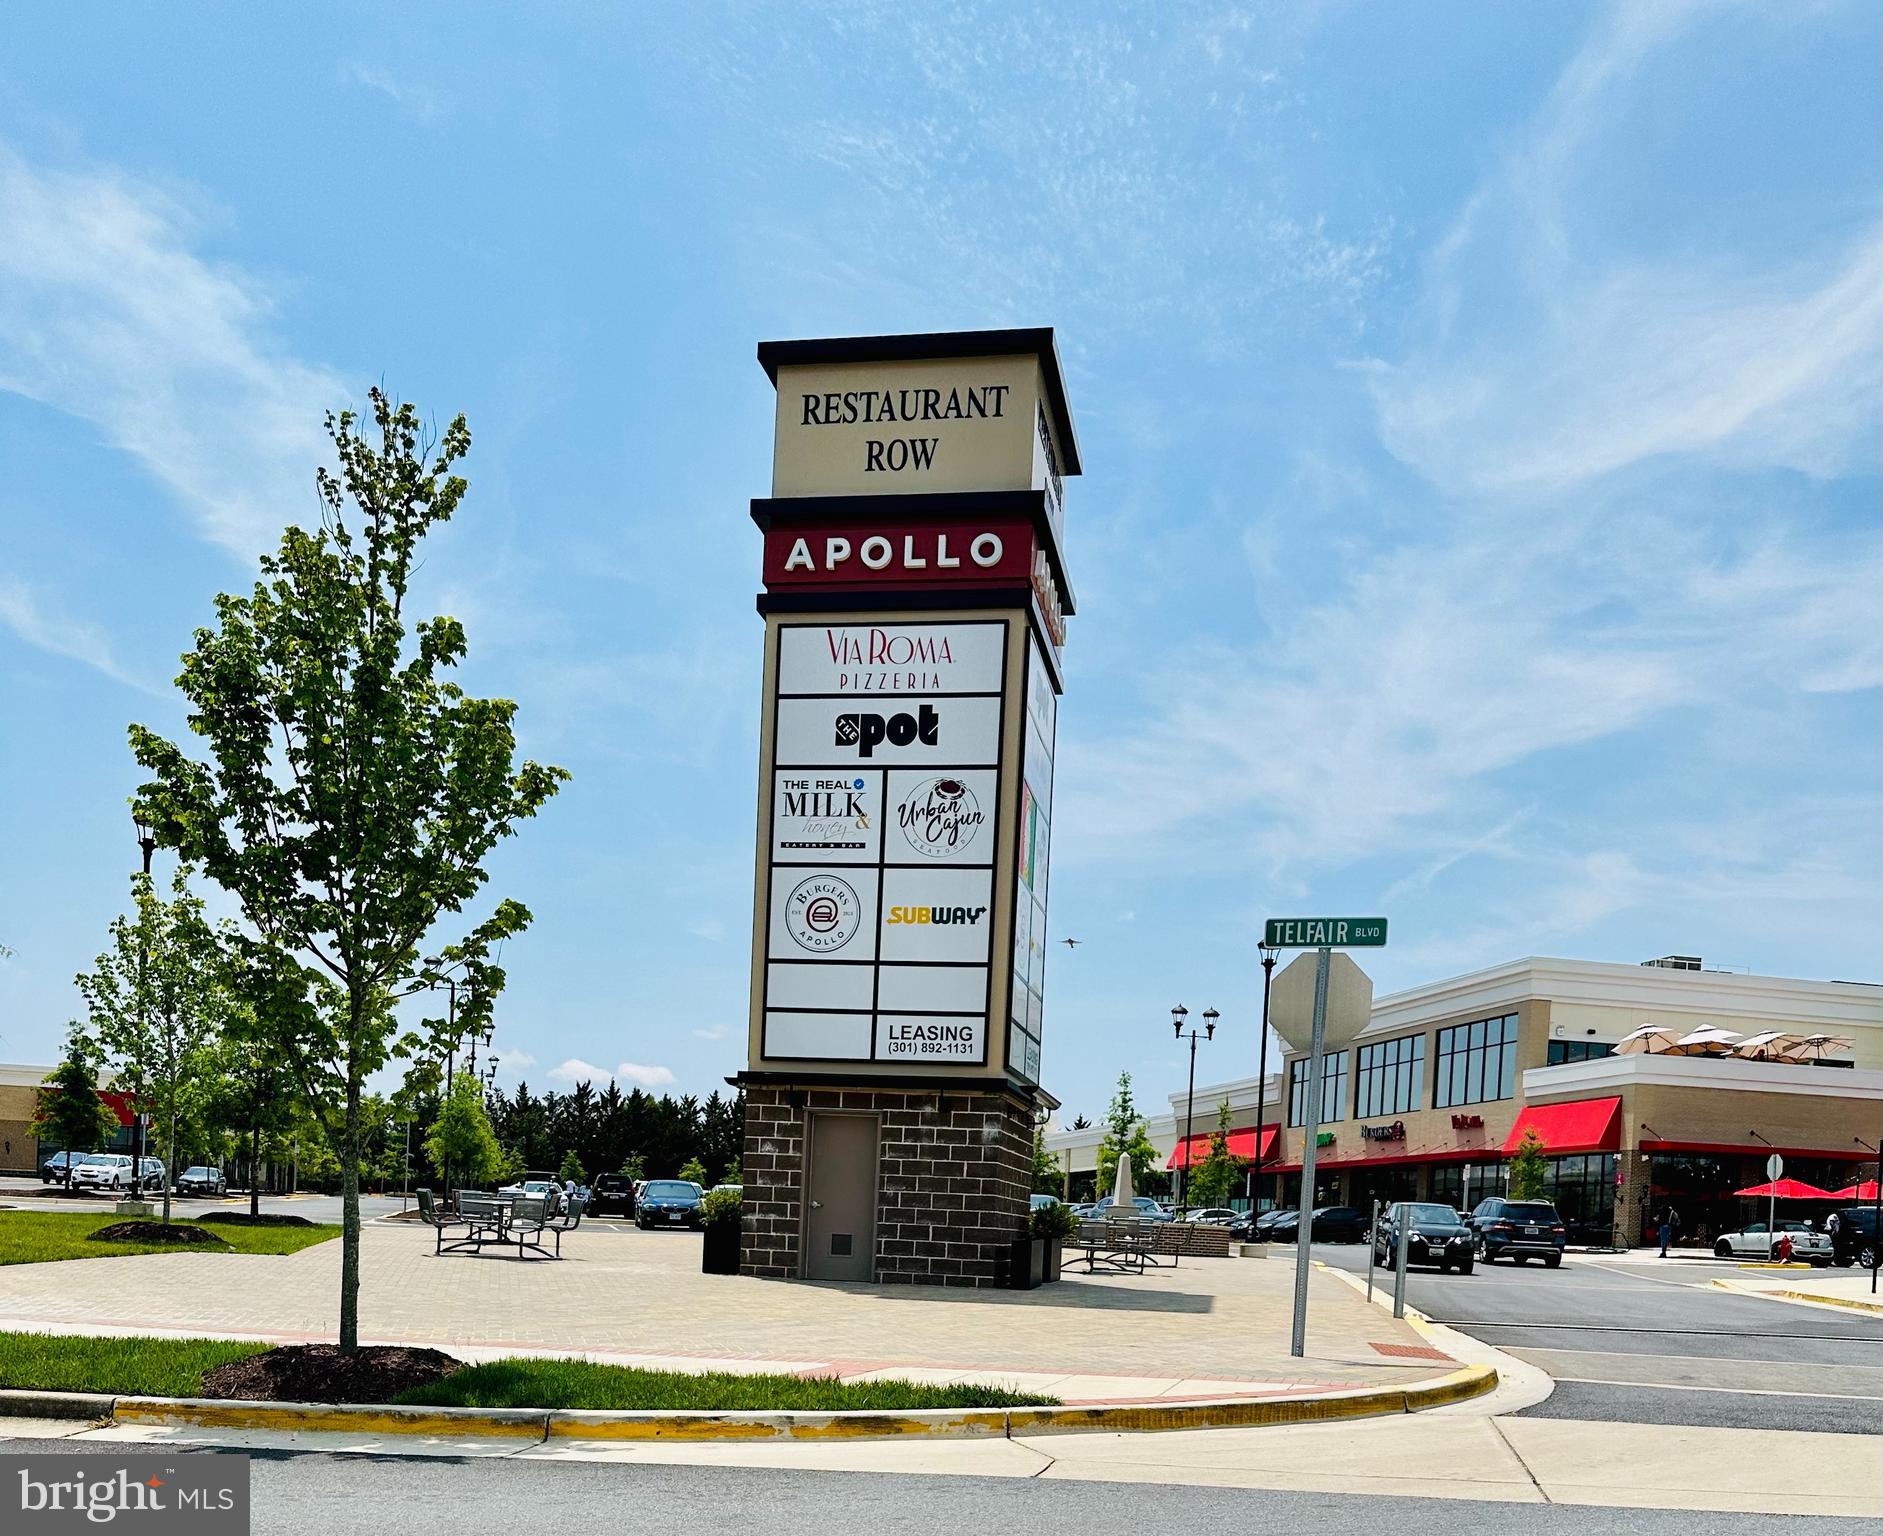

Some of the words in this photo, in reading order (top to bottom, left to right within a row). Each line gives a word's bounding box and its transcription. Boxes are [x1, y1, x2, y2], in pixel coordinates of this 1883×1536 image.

[801, 386, 1009, 426] RESTAURANT
[864, 438, 940, 472] ROW
[785, 533, 1003, 572] APOLLO
[840, 672, 940, 690] PIZZERIA
[838, 718, 858, 741] THE
[783, 780, 809, 790] THE
[816, 780, 852, 790] REAL
[781, 792, 867, 817] MILK
[897, 791, 962, 828] Urban
[926, 813, 986, 846] Cajun
[887, 906, 987, 925] SUBWAY
[799, 931, 845, 946] APOLLO
[1274, 921, 1348, 944] TELFAIR
[1355, 927, 1380, 937] BLVD
[889, 1025, 973, 1042] LEASING
[888, 1041, 918, 1055] (301)
[921, 1042, 974, 1055] 892-1131
